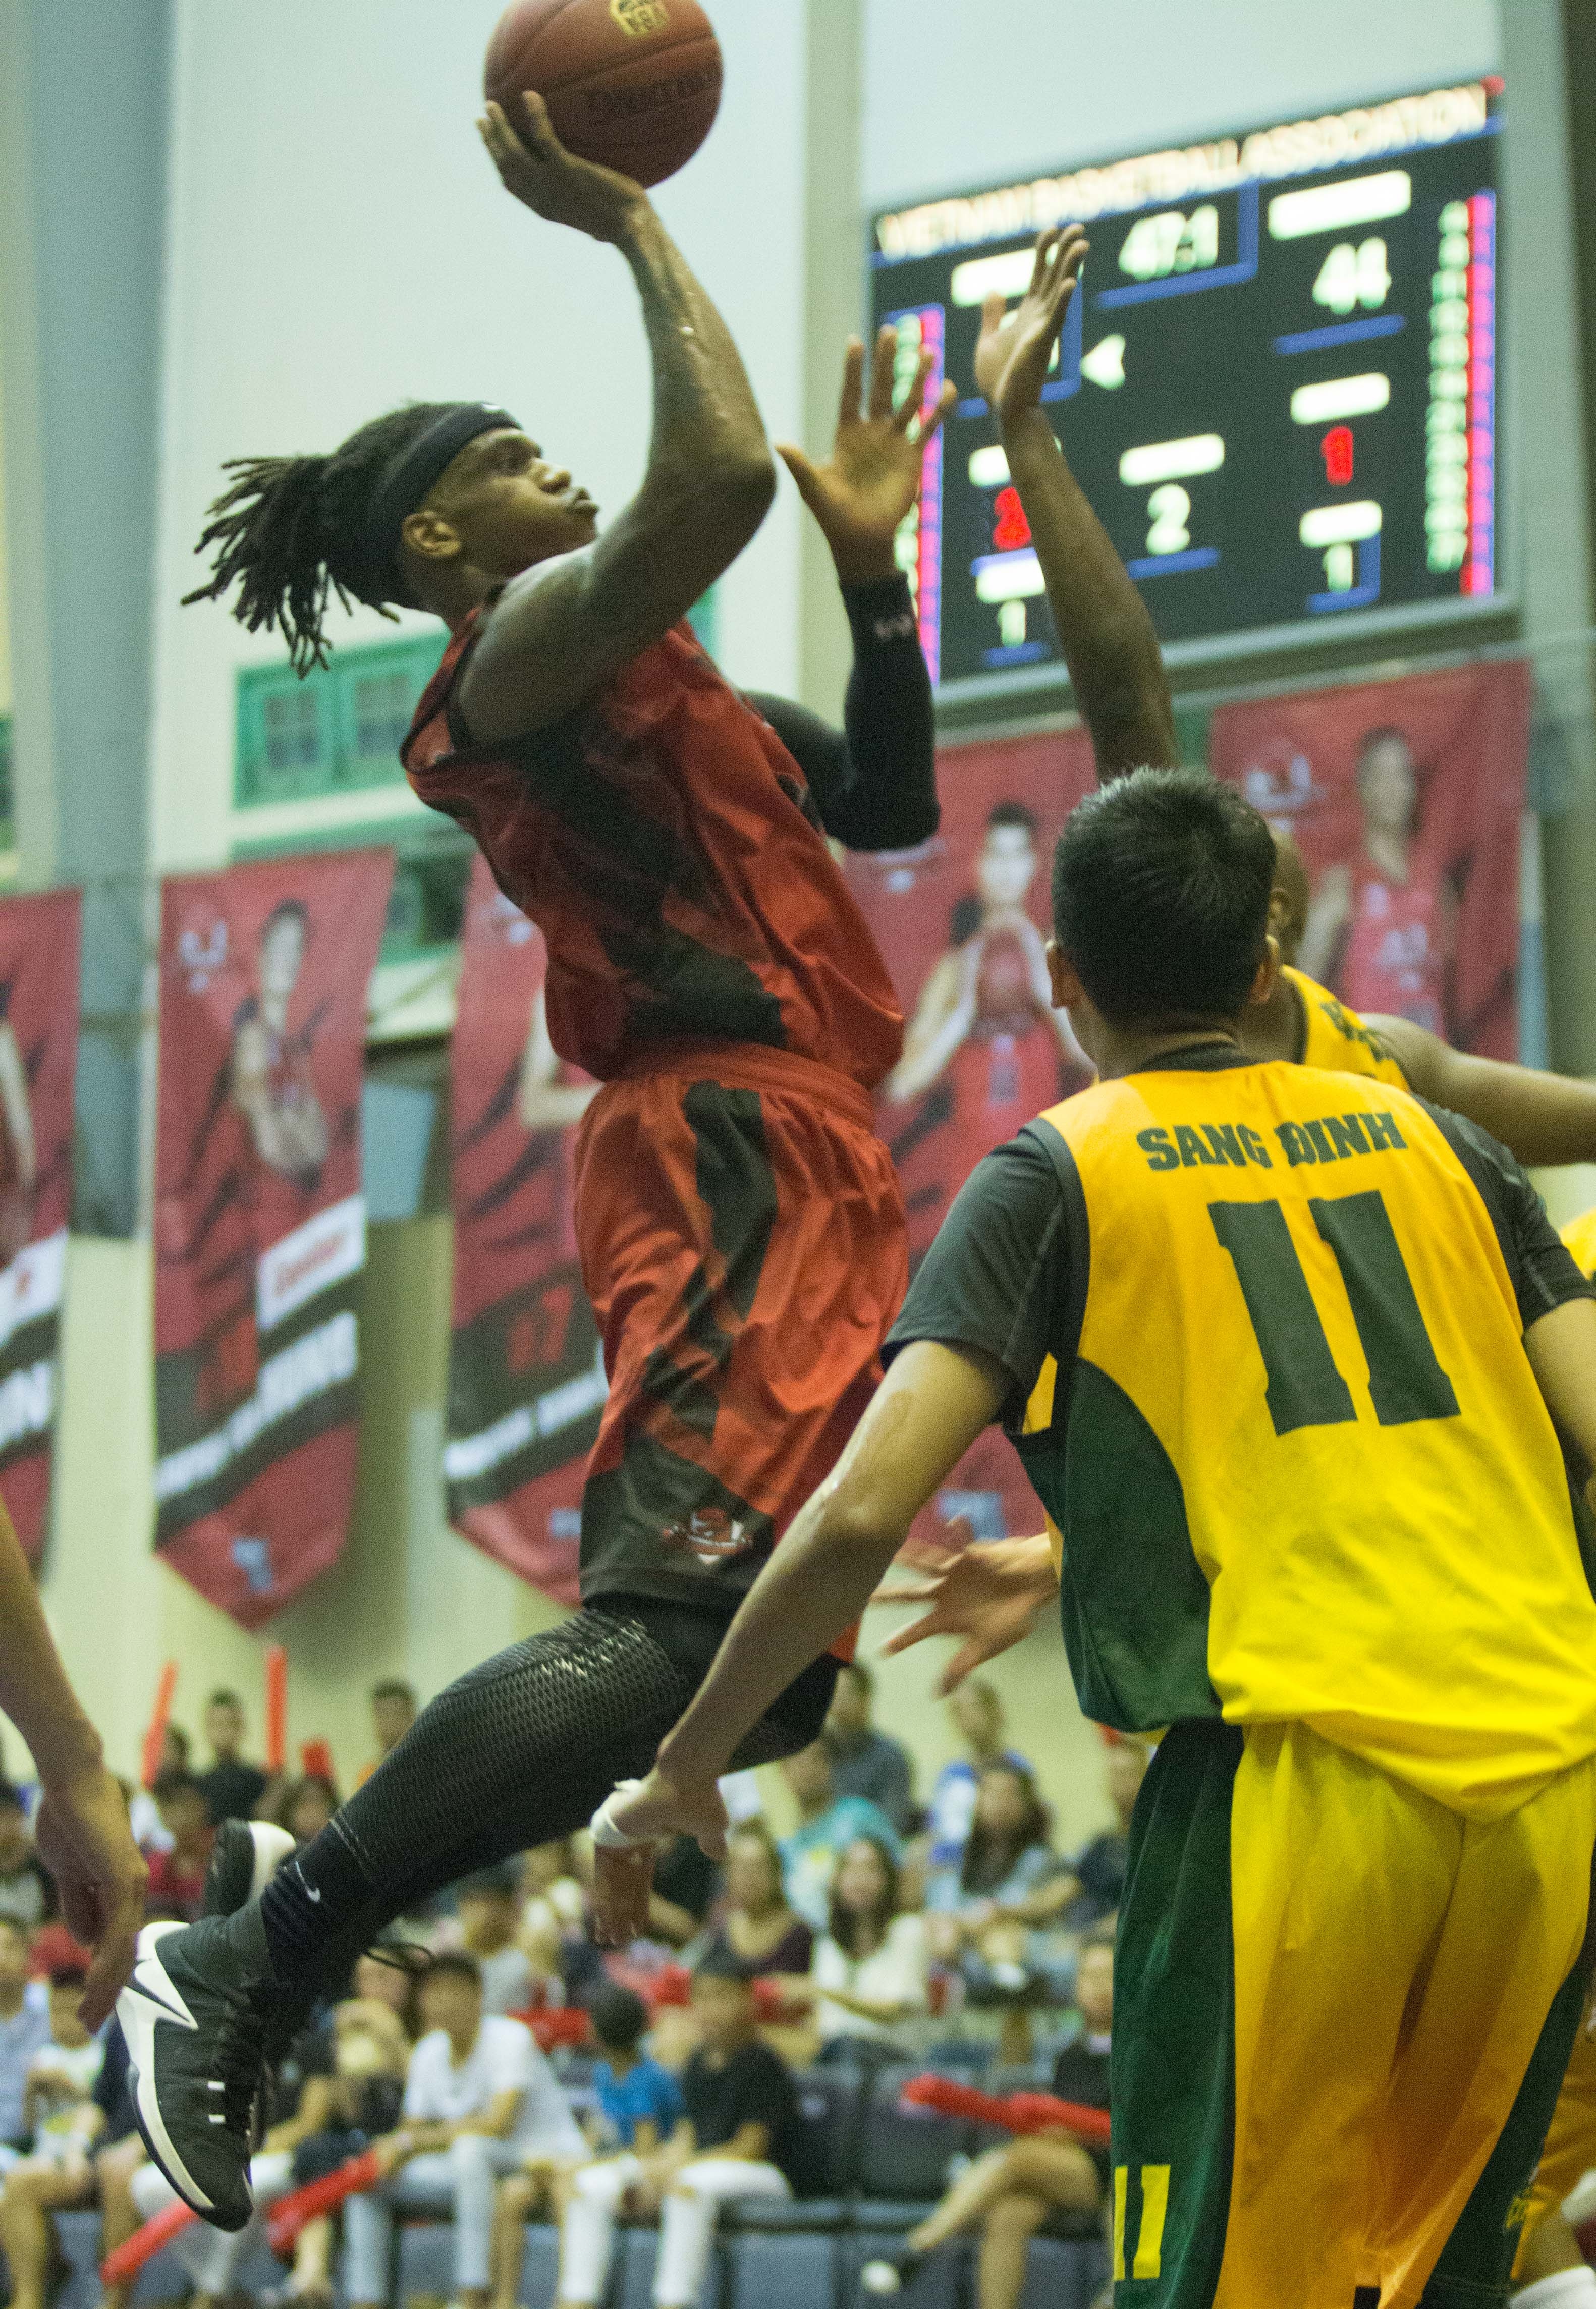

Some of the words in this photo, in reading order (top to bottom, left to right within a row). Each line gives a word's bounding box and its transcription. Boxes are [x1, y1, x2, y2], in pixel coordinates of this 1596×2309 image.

[1032, 139, 1242, 230] BASKETBALL
[1242, 84, 1487, 179] ASSOCIATION
[1146, 484, 1191, 555] 2
[1136, 1124, 1273, 1171] SANG
[1207, 1190, 1462, 1437] 11
